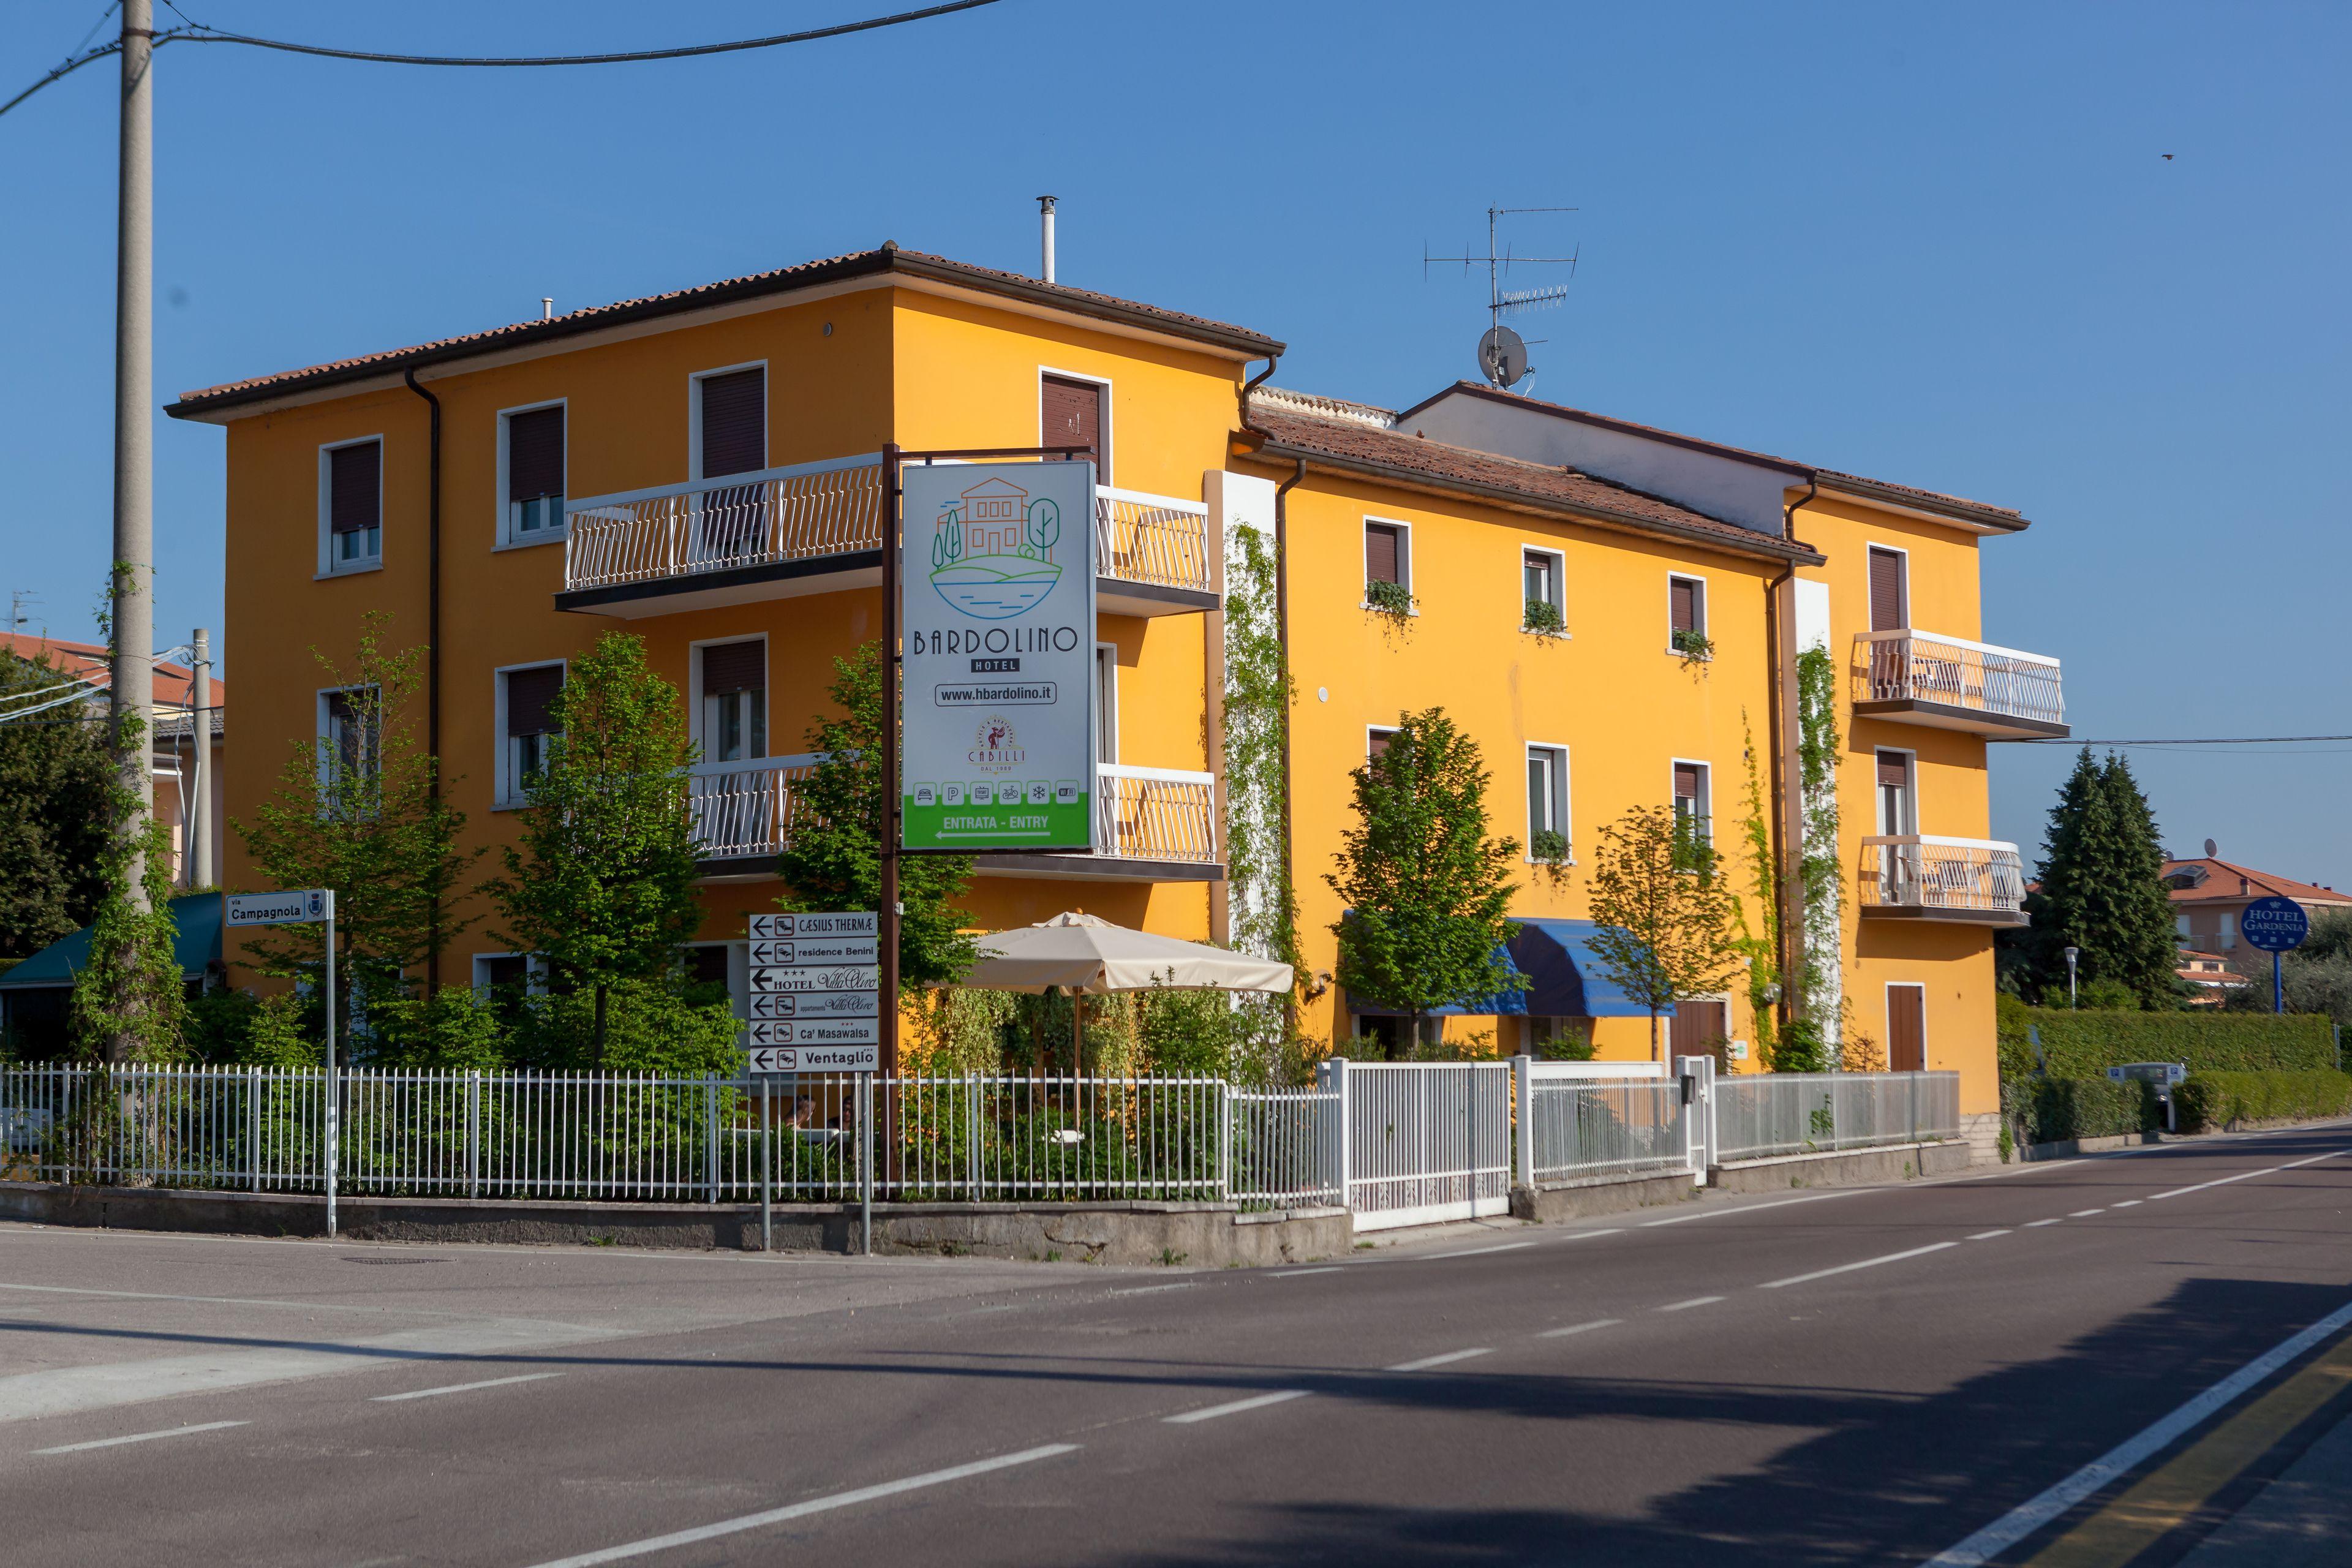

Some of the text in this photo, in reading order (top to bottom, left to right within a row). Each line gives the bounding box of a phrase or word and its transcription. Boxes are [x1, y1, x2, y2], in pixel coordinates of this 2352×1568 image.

[914, 627, 1078, 655] BARDOLINO
[975, 659, 1016, 671] HOTEL
[941, 687, 1051, 701] www.hbardolino.it
[968, 750, 1024, 762] CABILLI
[944, 817, 997, 829] ENTRATA
[1009, 816, 1049, 829] ENTRY
[232, 905, 301, 920] Campagnola
[2249, 910, 2303, 922] HOTEL
[799, 918, 873, 932] CÆSIUS THERMÆ
[2244, 919, 2304, 932] GARDENIA
[798, 947, 873, 957] residence Benini
[774, 967, 876, 990] HOTEL Villa Olivo
[825, 995, 848, 1010] Villa
[846, 995, 874, 1014] Olivo
[818, 1029, 869, 1039] Masawalsa
[805, 1052, 873, 1065] Ventaglio
